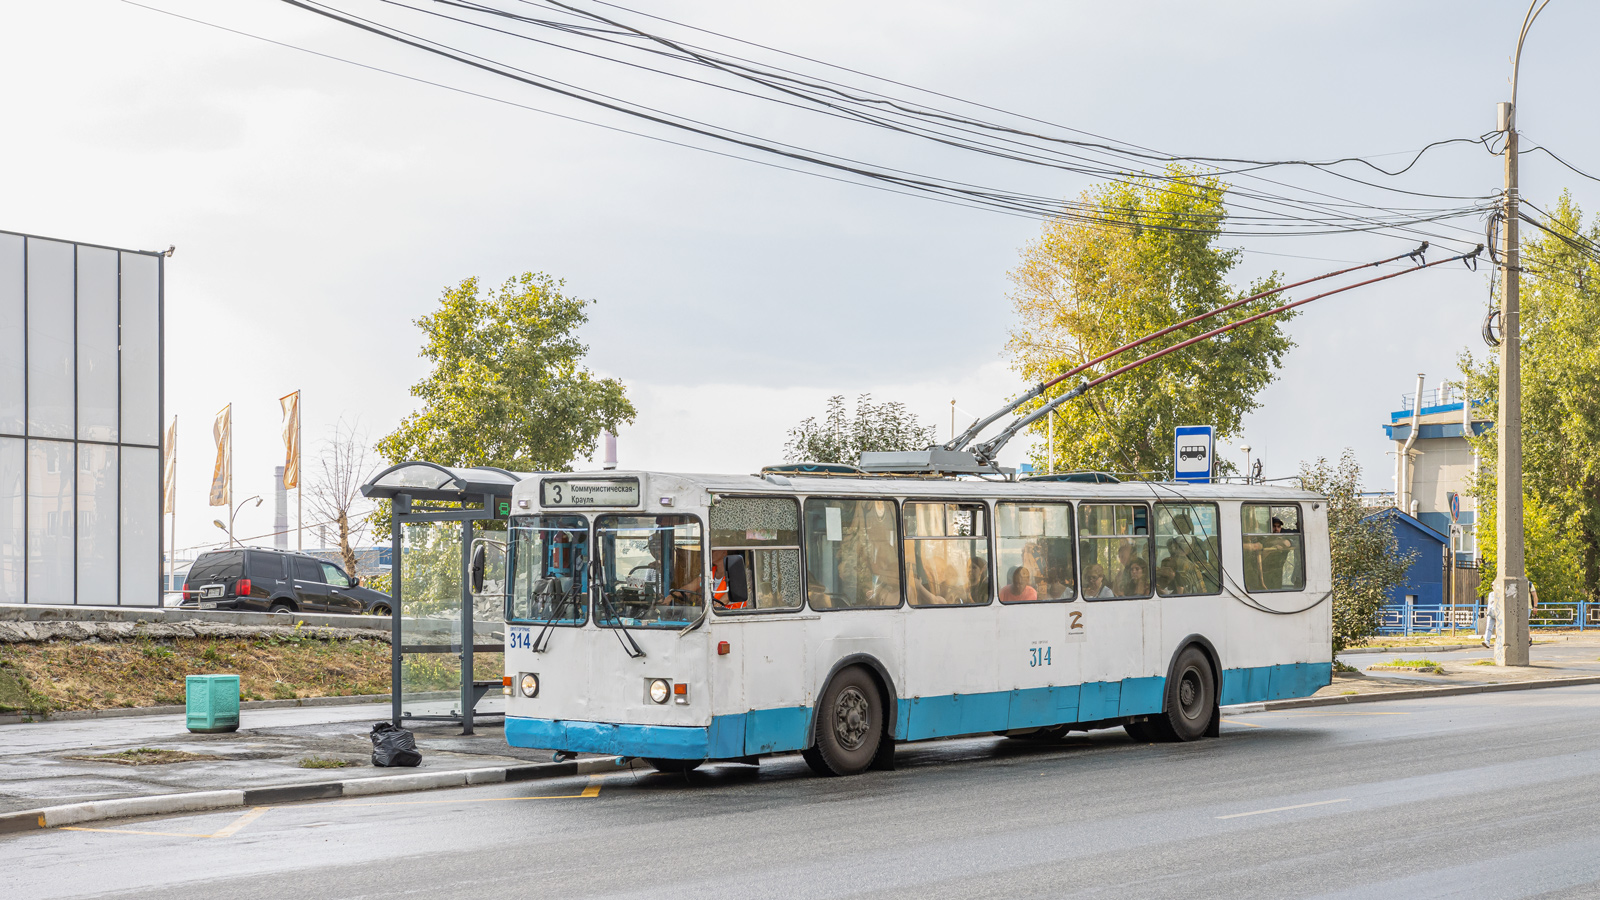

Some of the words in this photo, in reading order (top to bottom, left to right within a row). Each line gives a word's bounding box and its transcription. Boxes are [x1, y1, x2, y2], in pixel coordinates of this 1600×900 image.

[553, 485, 563, 504] 3
[571, 485, 635, 494] Коммунистическая-
[571, 496, 594, 504] Крауля
[510, 632, 530, 649] 314
[1029, 646, 1051, 667] 314
